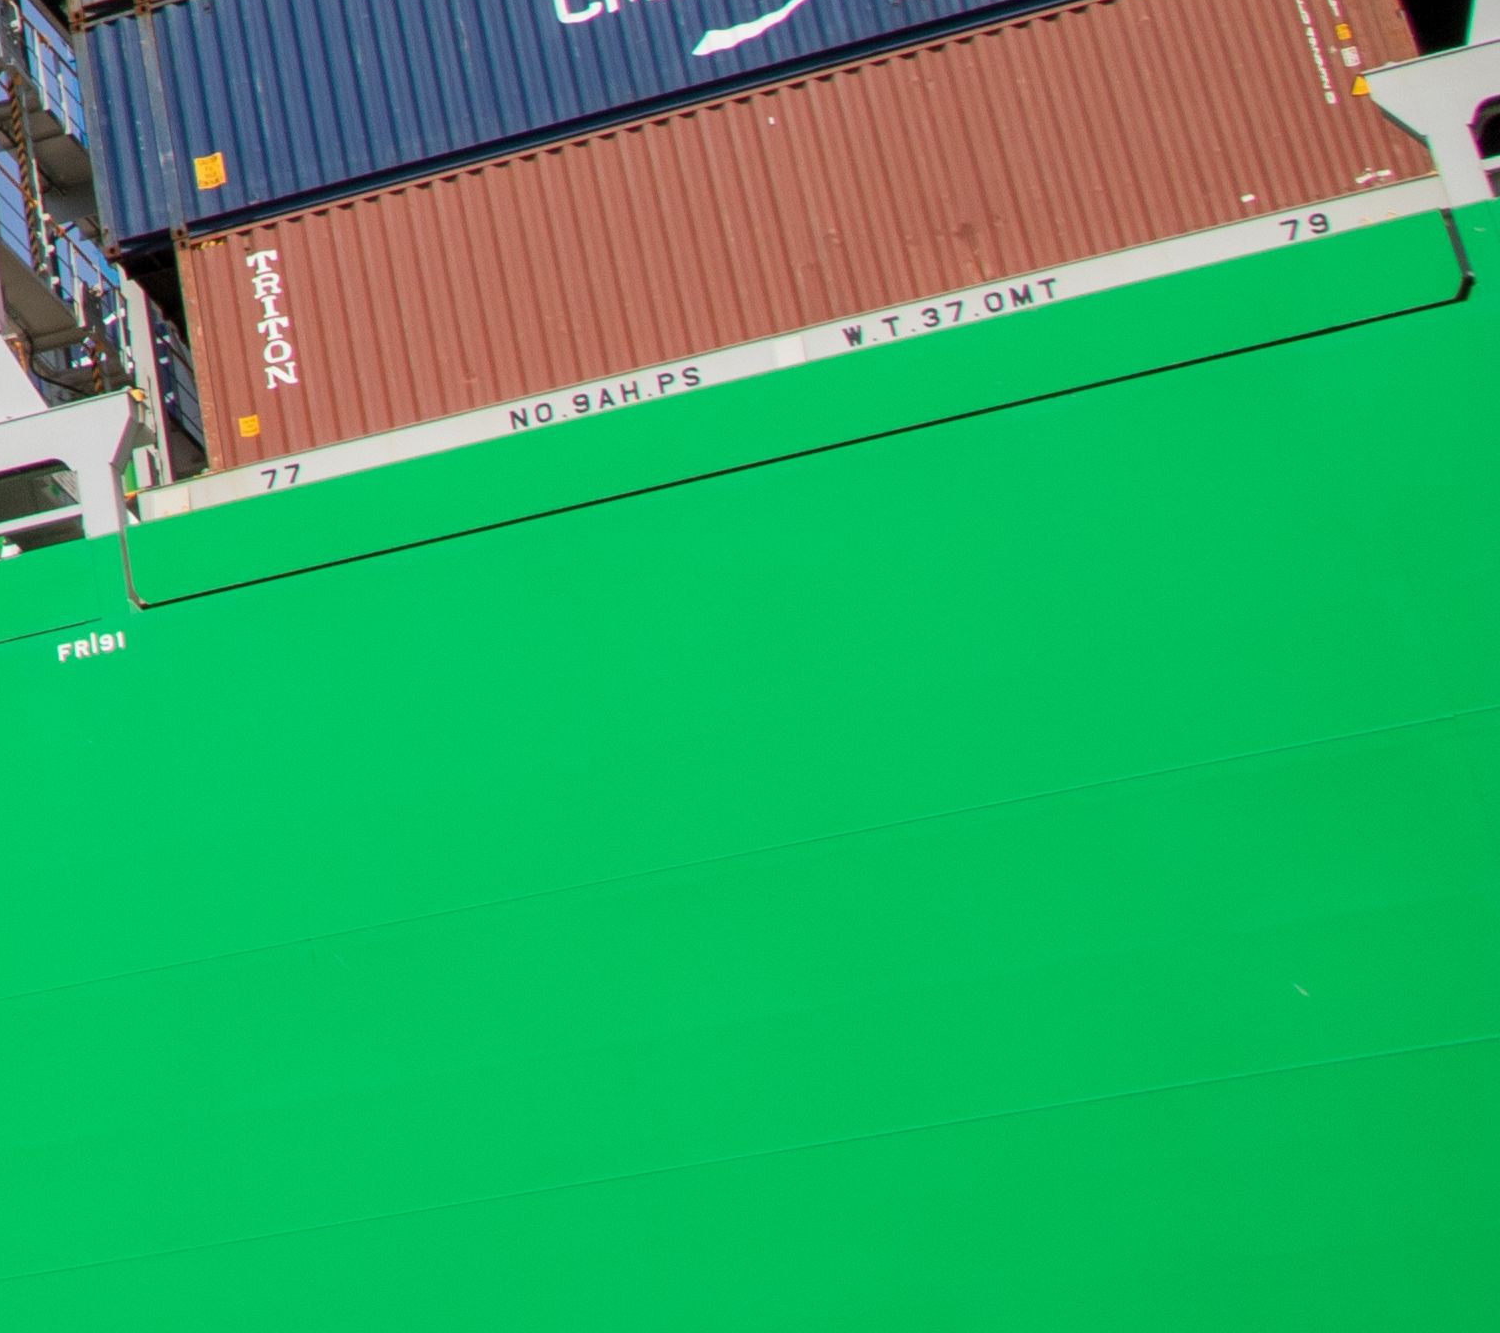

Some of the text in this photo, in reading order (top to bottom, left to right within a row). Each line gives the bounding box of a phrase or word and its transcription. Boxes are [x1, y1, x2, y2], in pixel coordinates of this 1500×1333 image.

[1280, 212, 1333, 241] 79
[245, 248, 299, 391] TRITON
[260, 463, 303, 490] 77
